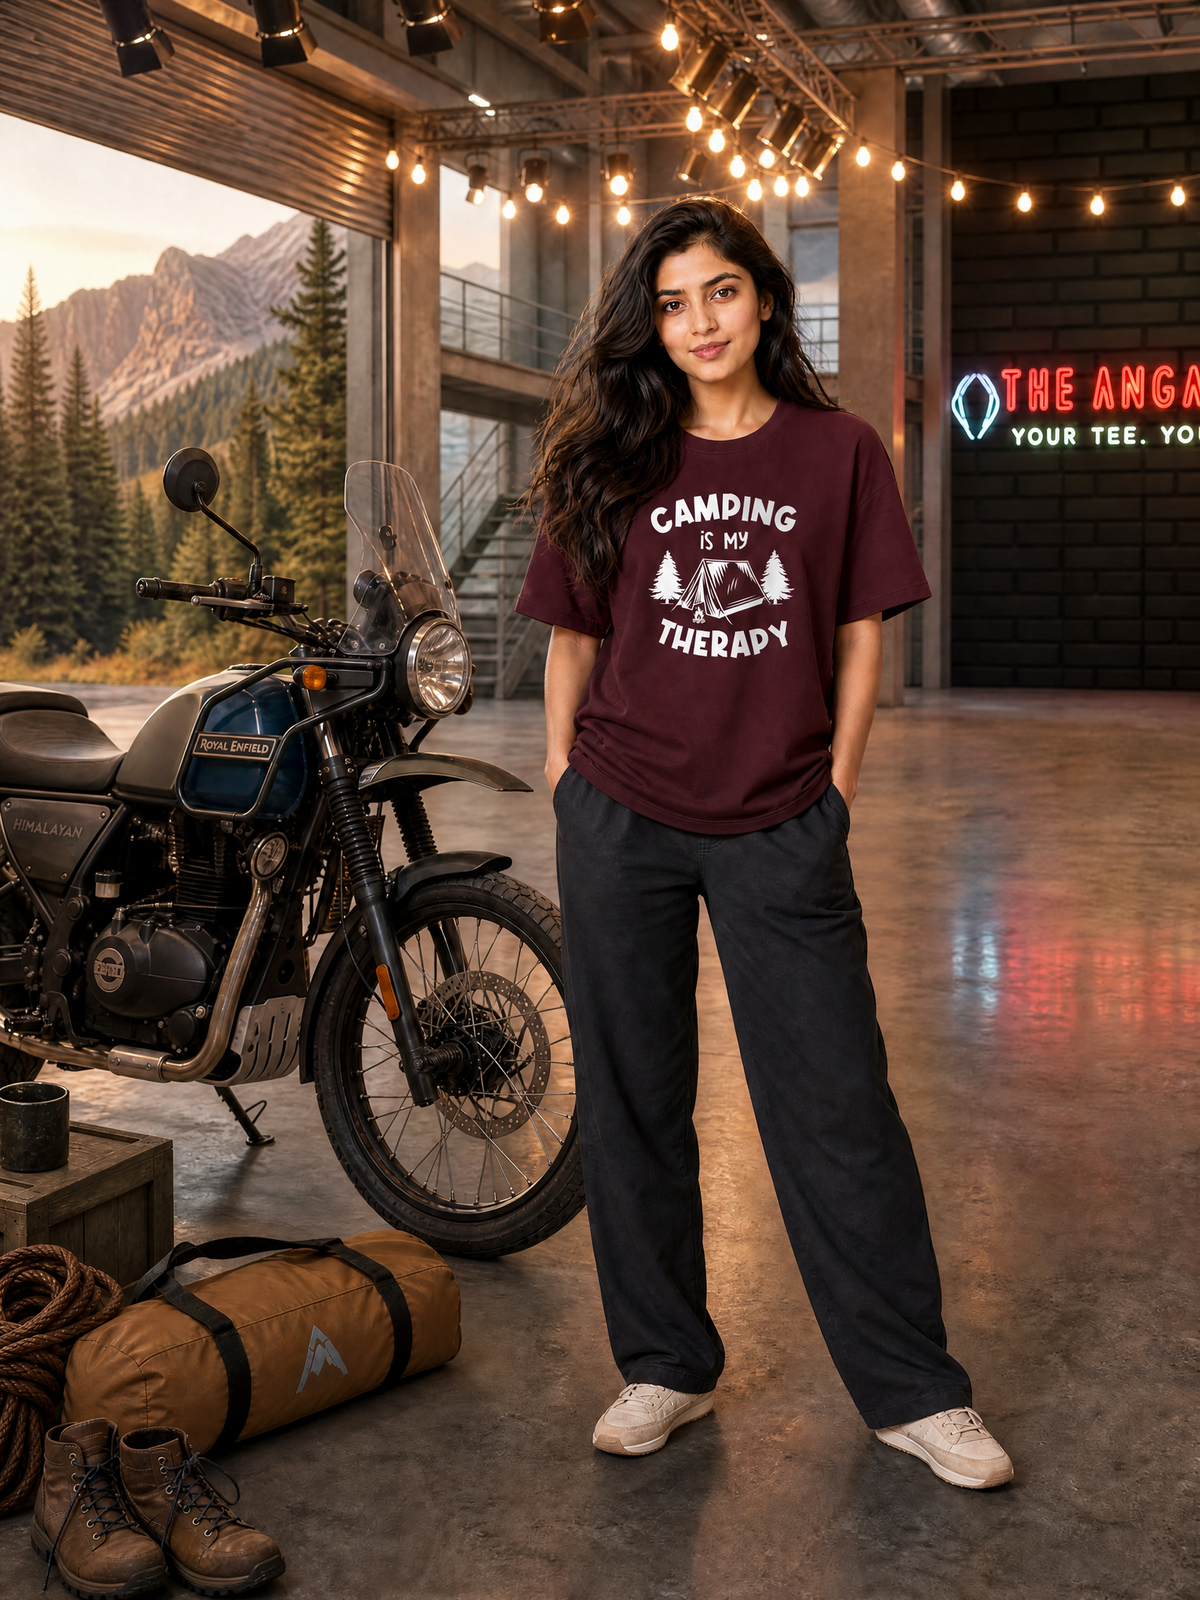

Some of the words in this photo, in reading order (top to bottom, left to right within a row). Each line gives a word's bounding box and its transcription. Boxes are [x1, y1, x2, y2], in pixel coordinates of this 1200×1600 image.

[1001, 366, 1074, 412] THE
[1092, 365, 1200, 410] ANGA
[1011, 427, 1076, 446] YOUR
[1091, 426, 1146, 445] TEE.
[1160, 425, 1200, 445] YO
[650, 493, 797, 533] CAMPING
[658, 618, 788, 658] THERAPY
[200, 738, 228, 751] ROYAL
[230, 740, 269, 754] ENFIELD
[13, 818, 83, 838] HIMALAYAN
